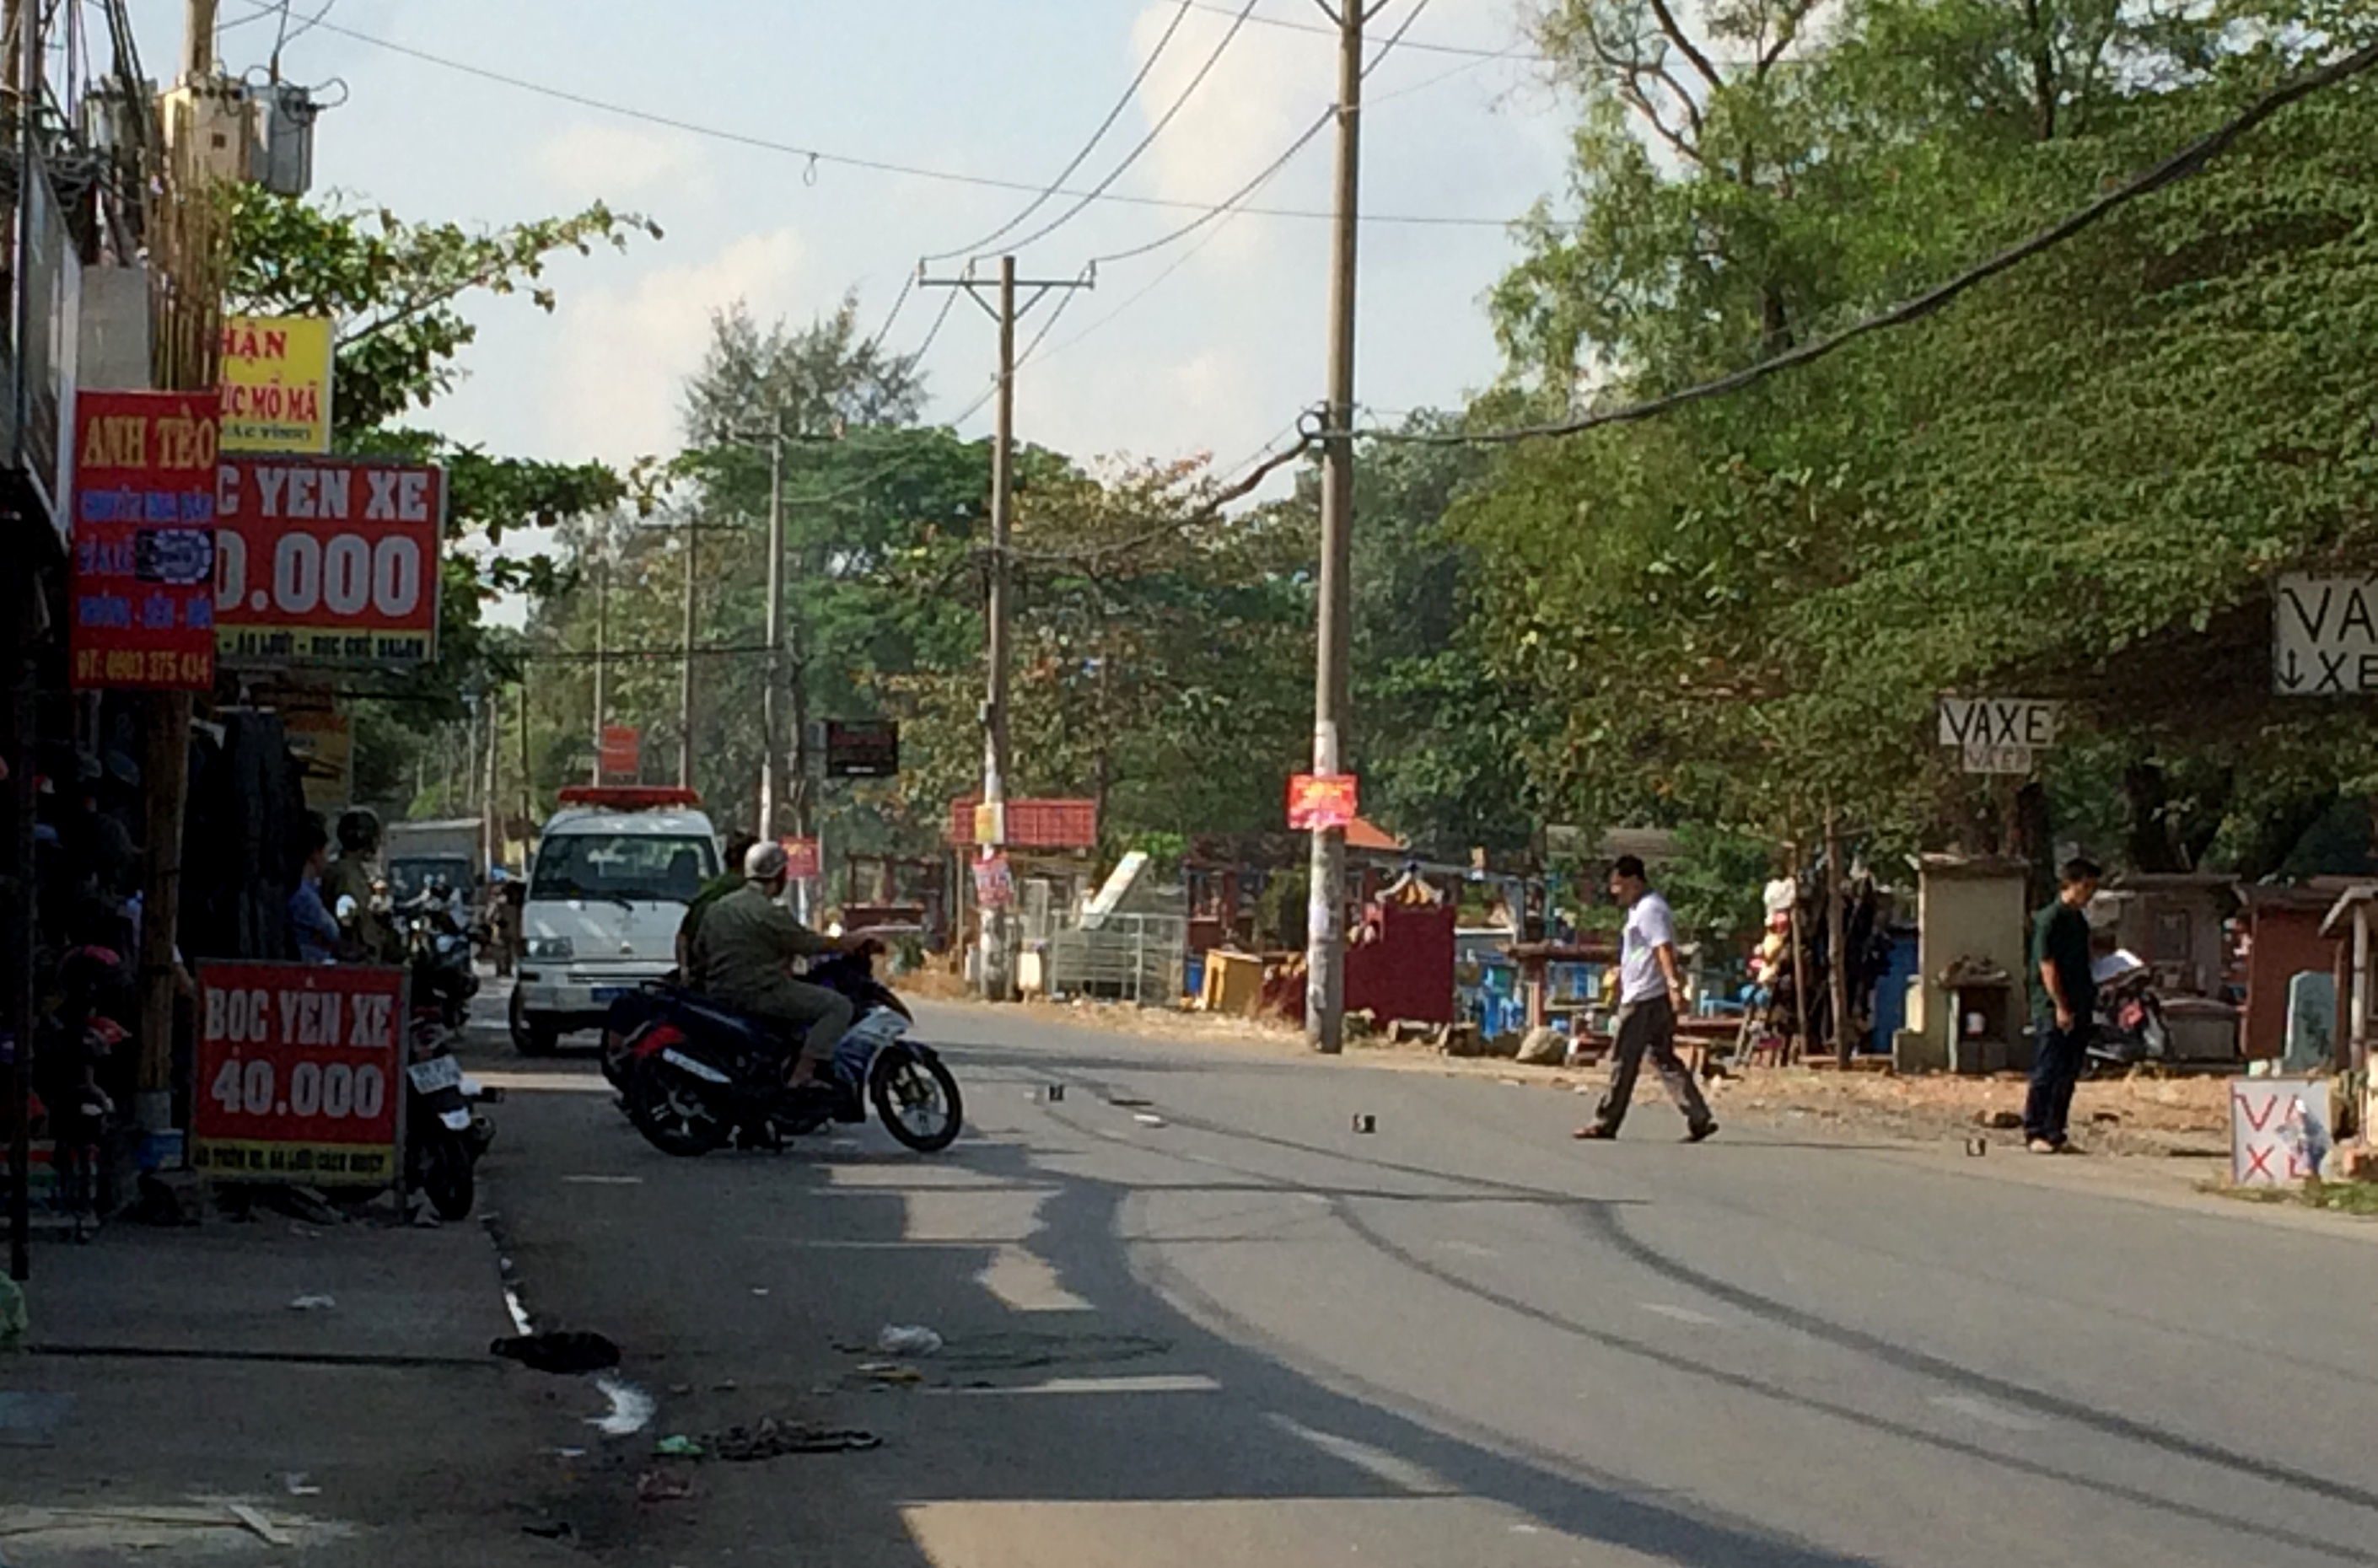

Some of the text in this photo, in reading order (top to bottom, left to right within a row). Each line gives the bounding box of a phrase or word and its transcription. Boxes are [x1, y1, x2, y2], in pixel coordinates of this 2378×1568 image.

[82, 402, 215, 470] ANH TÈO
[364, 470, 428, 523] XE
[216, 529, 420, 617] 0.000
[278, 975, 342, 1045] YÊN
[350, 993, 393, 1047] XE
[212, 1058, 385, 1120] 40.000
